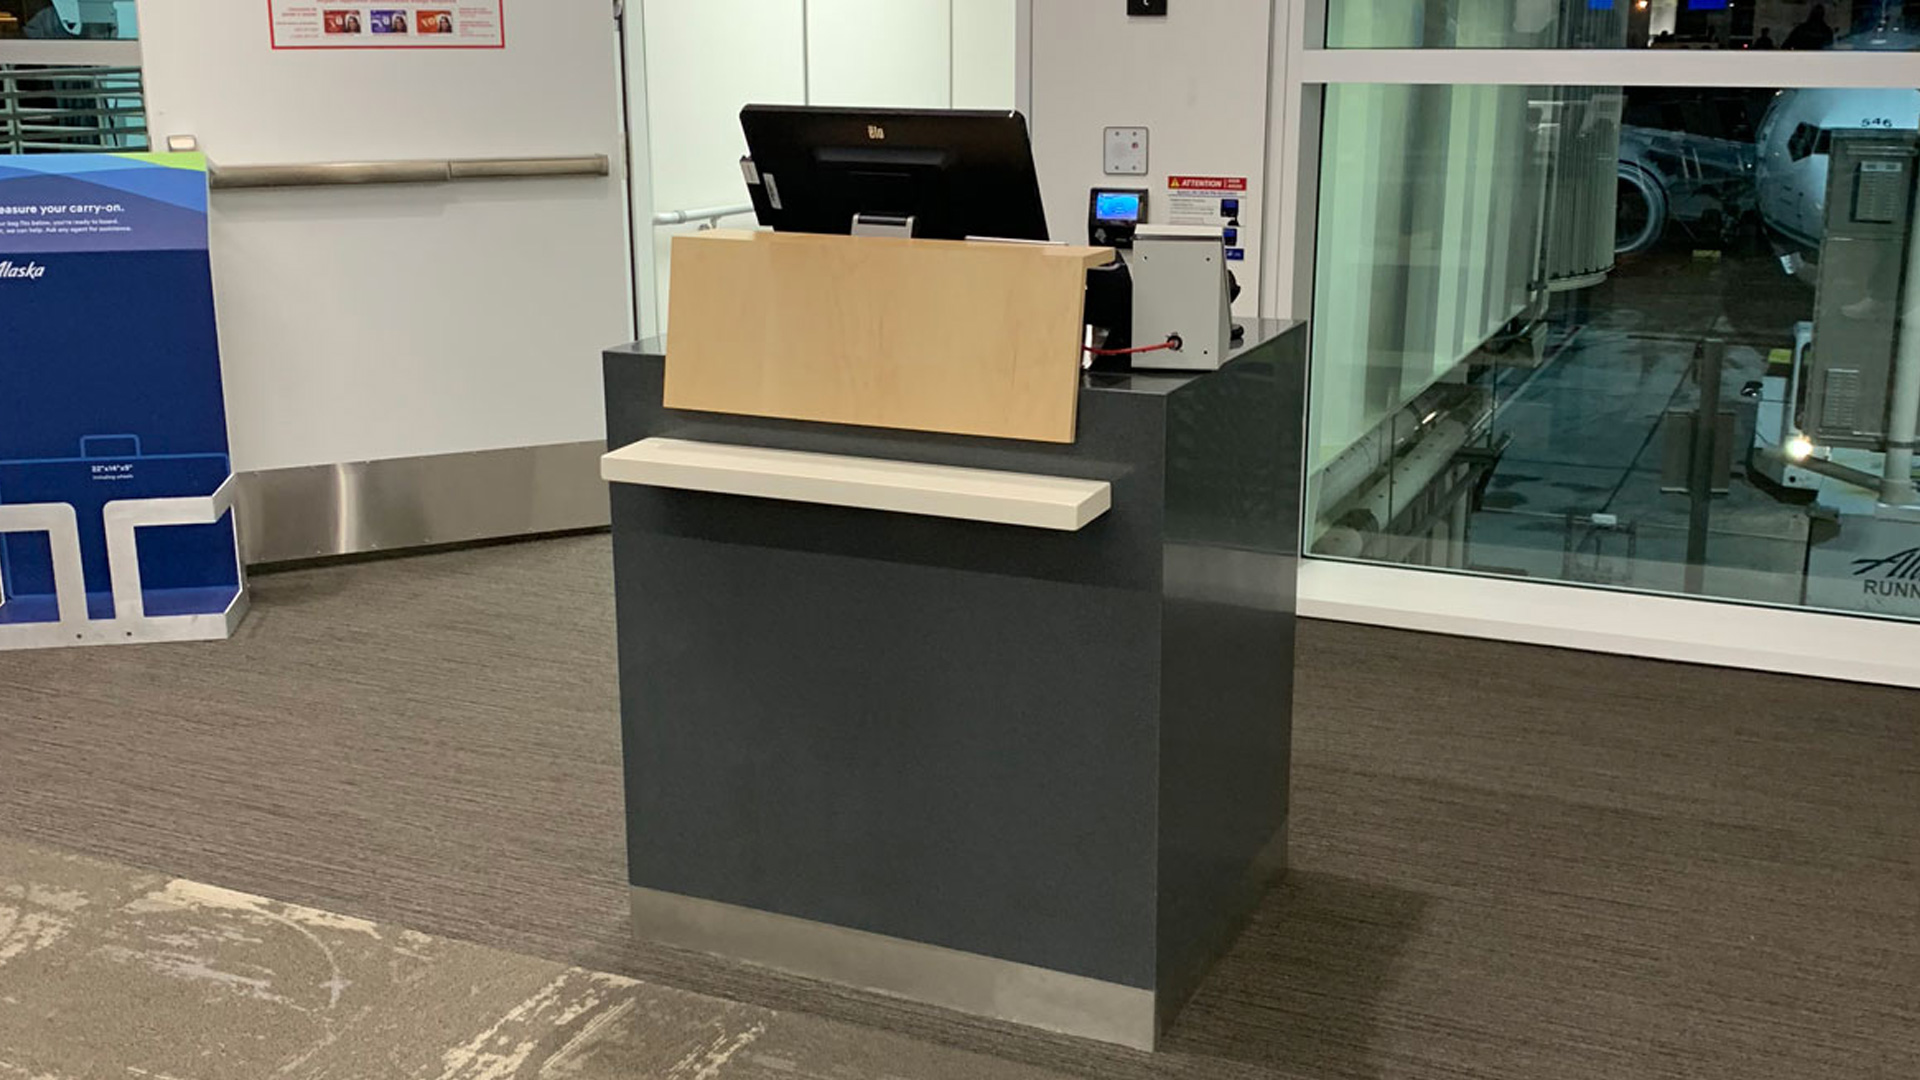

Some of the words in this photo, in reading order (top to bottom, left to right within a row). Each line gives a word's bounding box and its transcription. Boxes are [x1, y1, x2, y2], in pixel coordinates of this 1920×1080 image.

[1862, 117, 1893, 128] 546
[1181, 179, 1222, 187] ATTENTION
[39, 205, 68, 216] your
[69, 204, 125, 215] carry-on.
